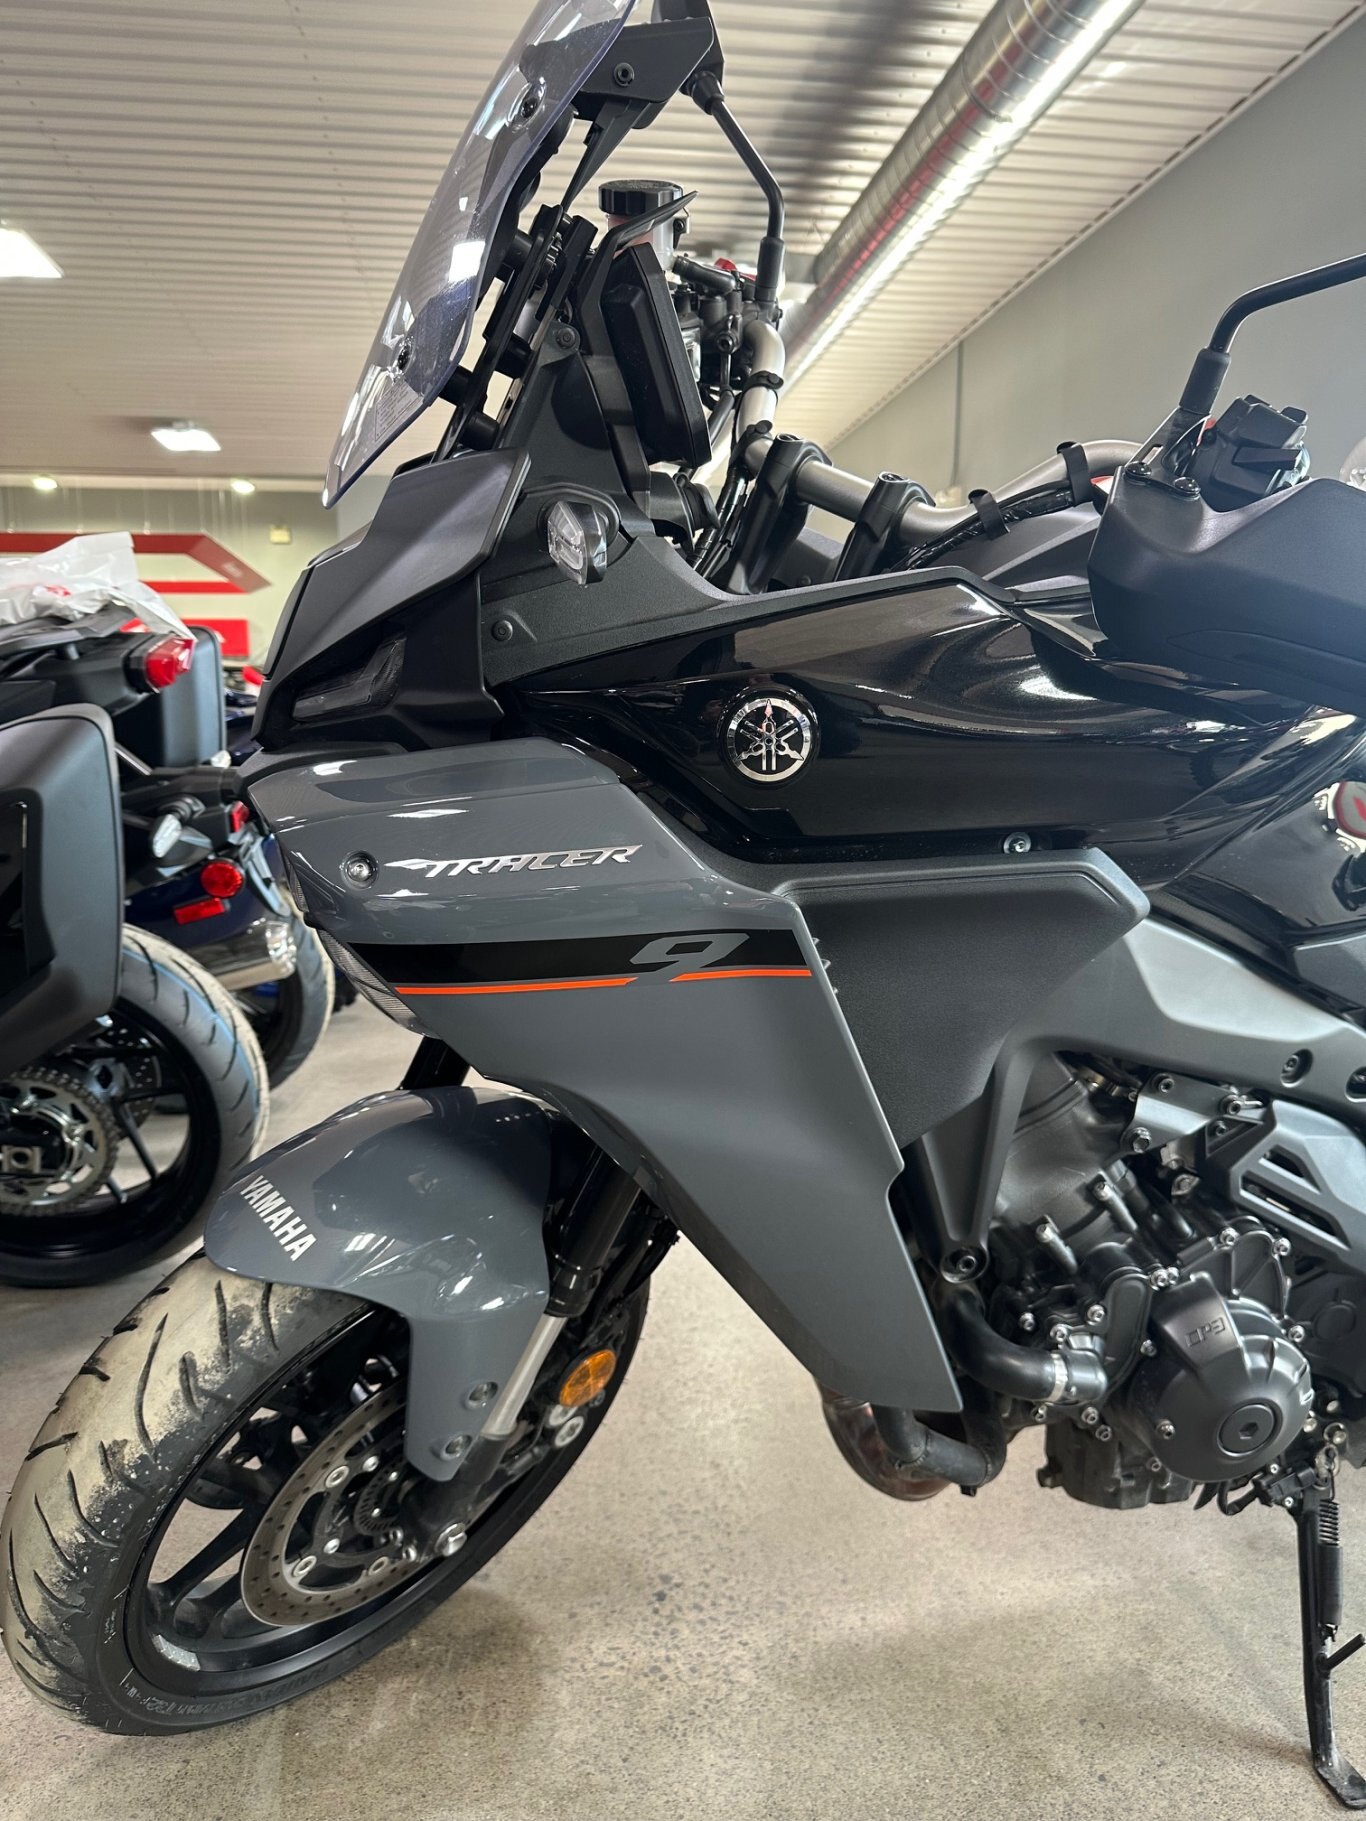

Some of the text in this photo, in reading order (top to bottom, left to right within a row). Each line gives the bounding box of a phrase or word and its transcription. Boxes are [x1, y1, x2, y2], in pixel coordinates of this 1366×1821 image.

[384, 844, 642, 878] TRACER
[629, 932, 750, 978] 9
[240, 1174, 317, 1262] YAMAHA
